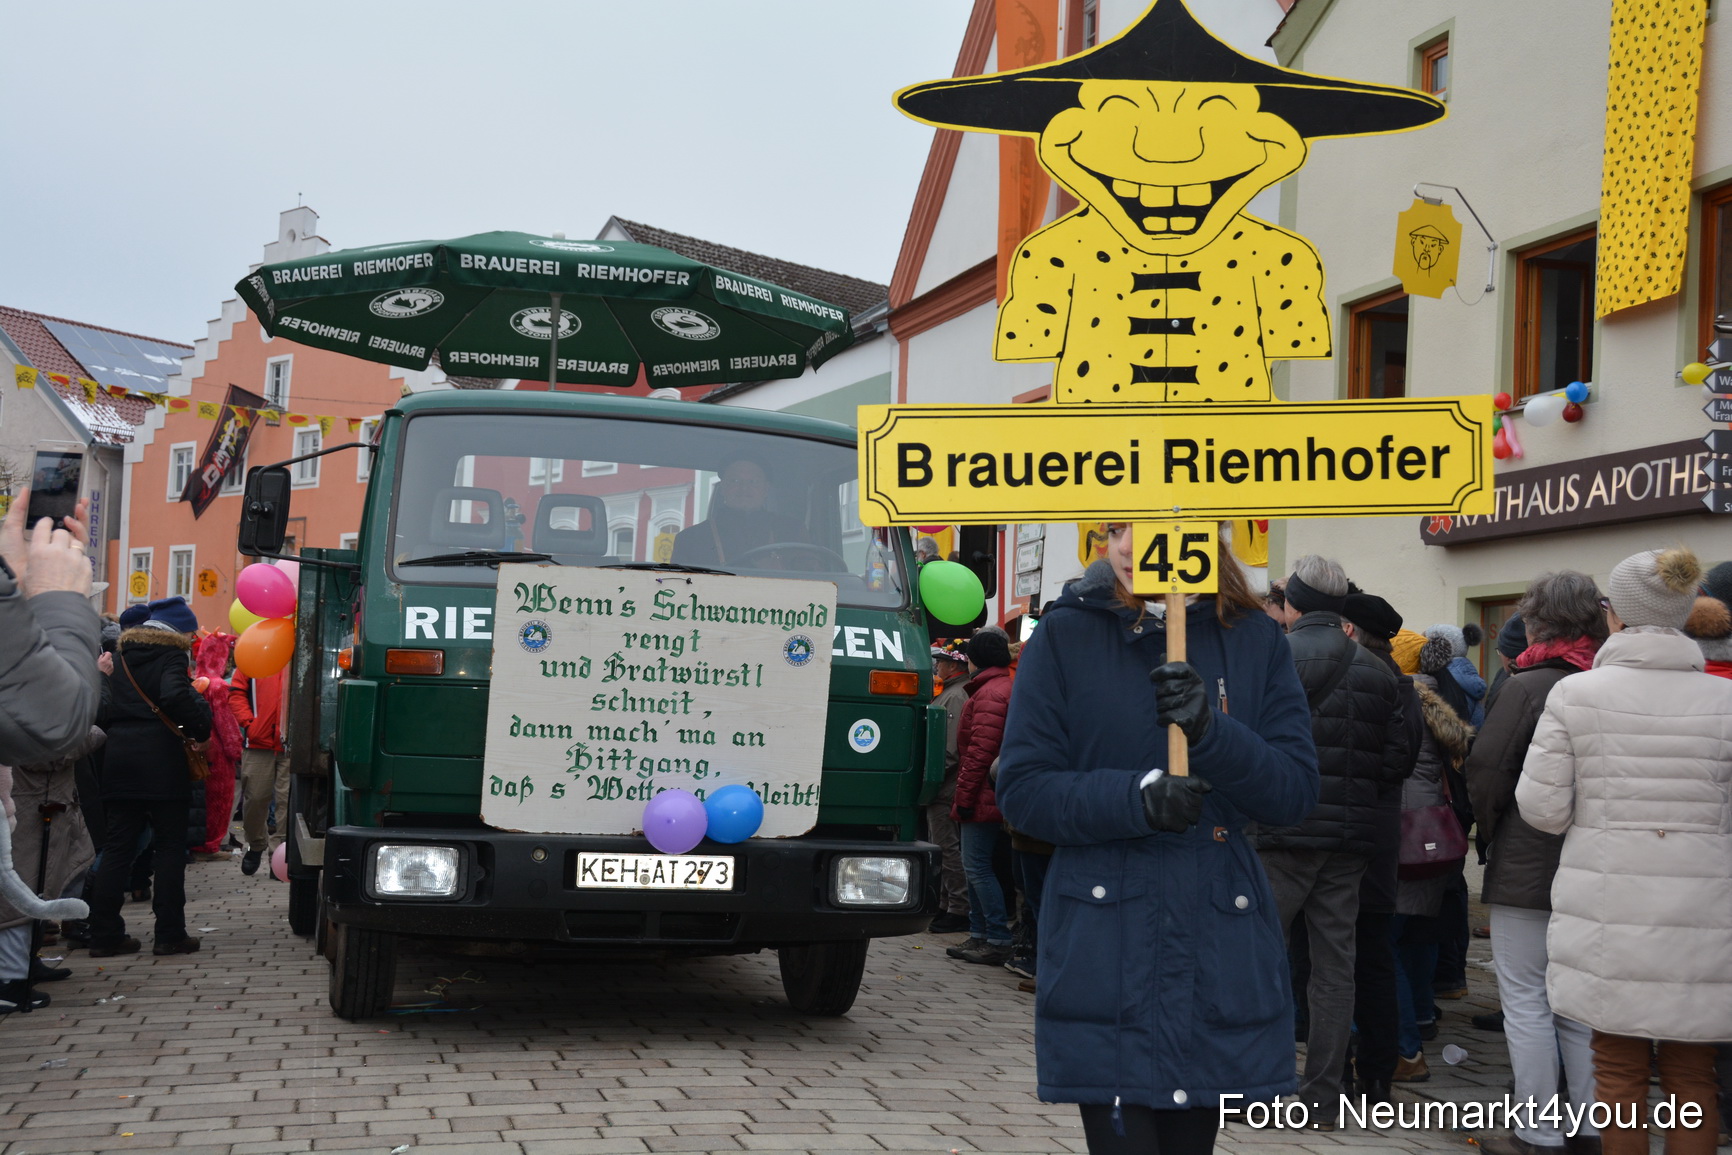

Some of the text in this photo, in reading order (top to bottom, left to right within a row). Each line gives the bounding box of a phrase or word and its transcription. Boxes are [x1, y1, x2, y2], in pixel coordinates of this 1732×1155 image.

[273, 252, 434, 285] BRAUEREI RIEMHOFER
[460, 253, 691, 286] BRAUEREI RIEMHOFER
[715, 275, 844, 323] BRAUEREI RIEMHOFER
[897, 435, 1450, 488] Brauerei Riemhofer
[1584, 452, 1731, 509] APOTHE
[89, 490, 100, 548] UHREN
[1139, 532, 1212, 584] 45
[513, 582, 829, 631] Wenn's Schwanengold
[622, 628, 702, 658] rengt
[539, 651, 763, 688] und Bratwürstl
[509, 714, 573, 739] dann
[732, 731, 766, 747] an
[489, 774, 535, 807] daß
